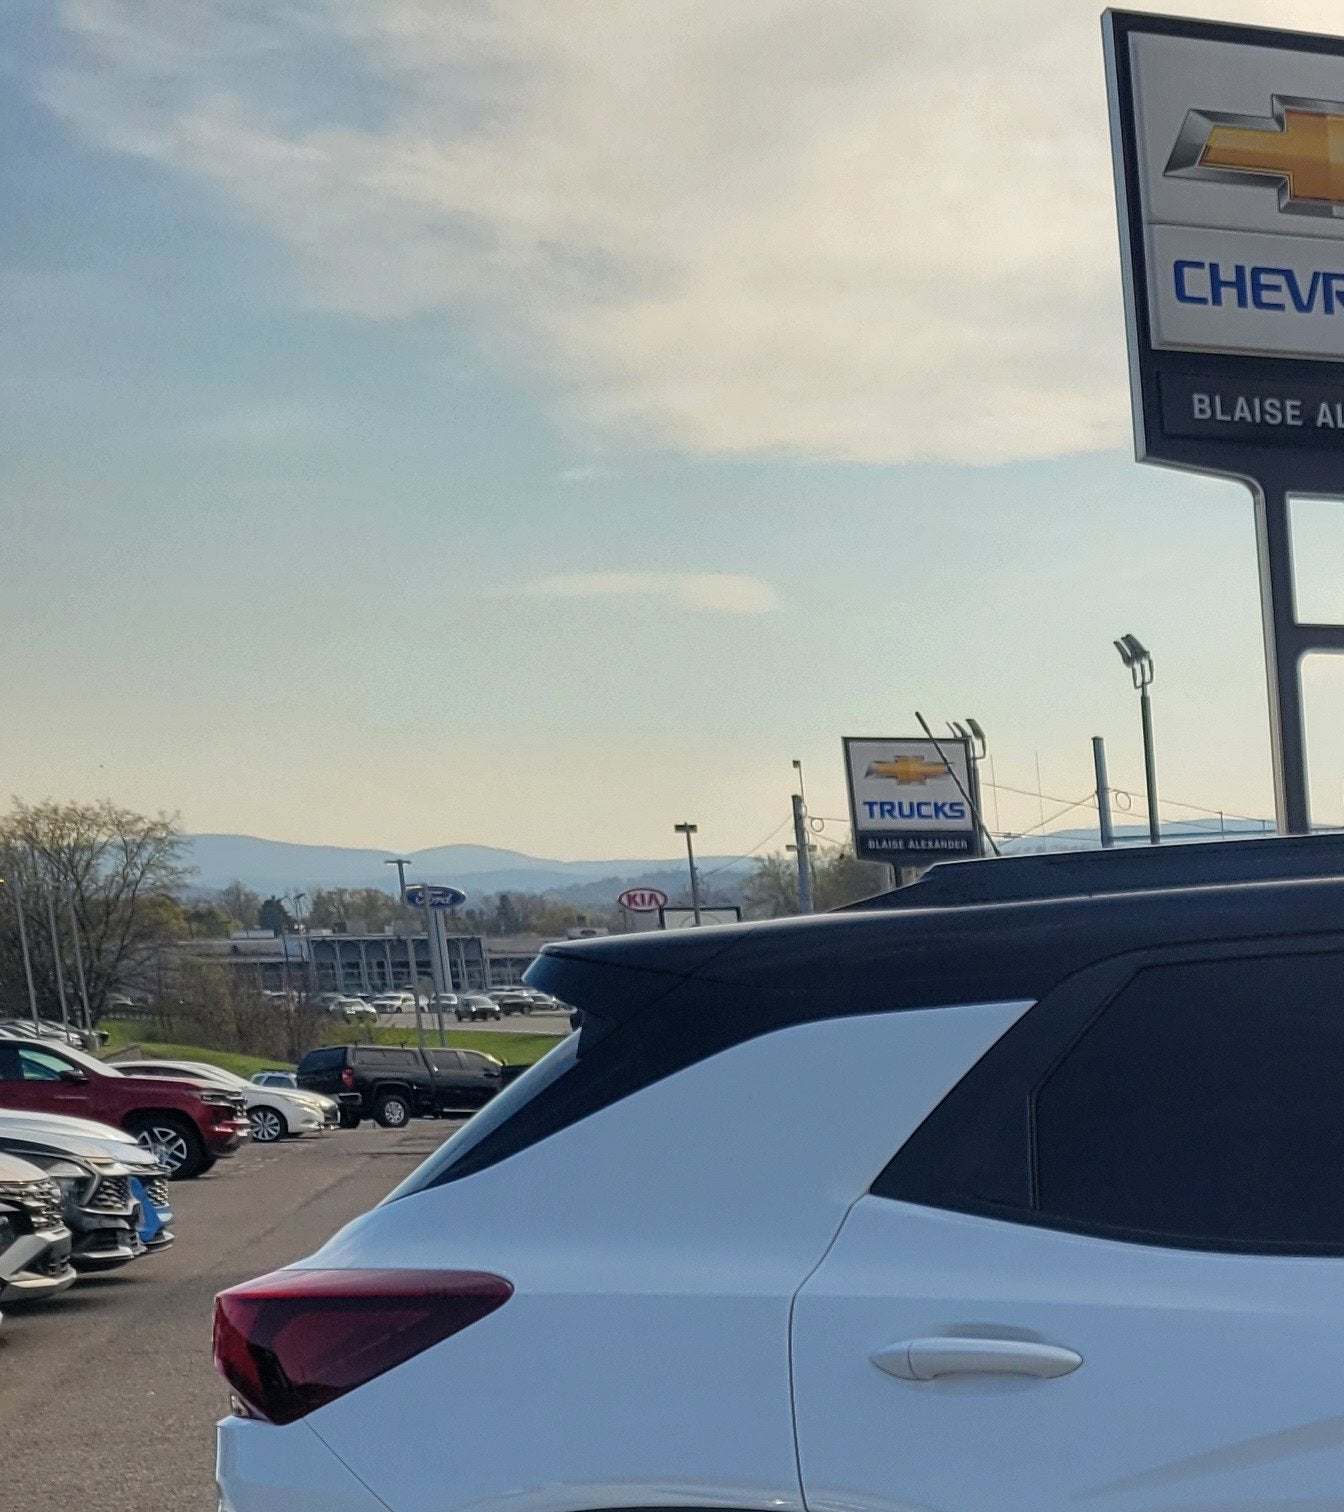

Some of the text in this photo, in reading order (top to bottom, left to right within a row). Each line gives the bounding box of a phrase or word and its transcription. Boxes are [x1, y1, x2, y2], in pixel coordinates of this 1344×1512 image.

[1192, 393, 1303, 427] BLAISE
[862, 801, 966, 820] TRUCKS
[868, 839, 969, 851] BLAISE ALEXANDER
[414, 890, 453, 906] Frd
[626, 893, 660, 908] KIA
